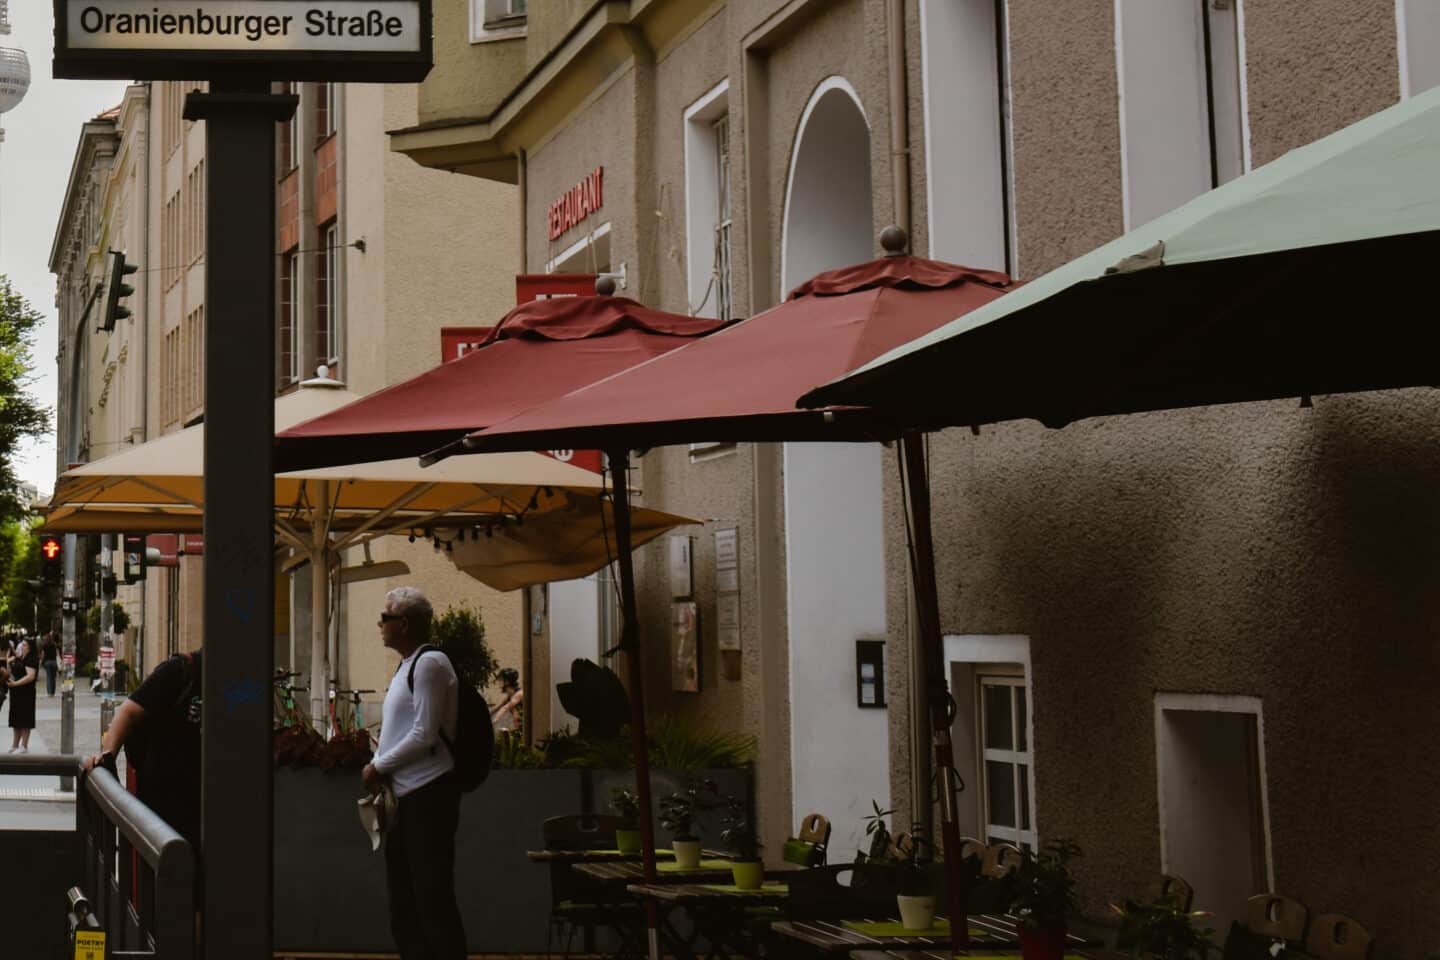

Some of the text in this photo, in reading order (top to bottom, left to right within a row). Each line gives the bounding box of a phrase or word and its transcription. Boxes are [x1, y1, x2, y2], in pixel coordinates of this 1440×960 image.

[80, 6, 403, 42] Oranienburger Straße
[548, 166, 604, 242] RESTAURANT
